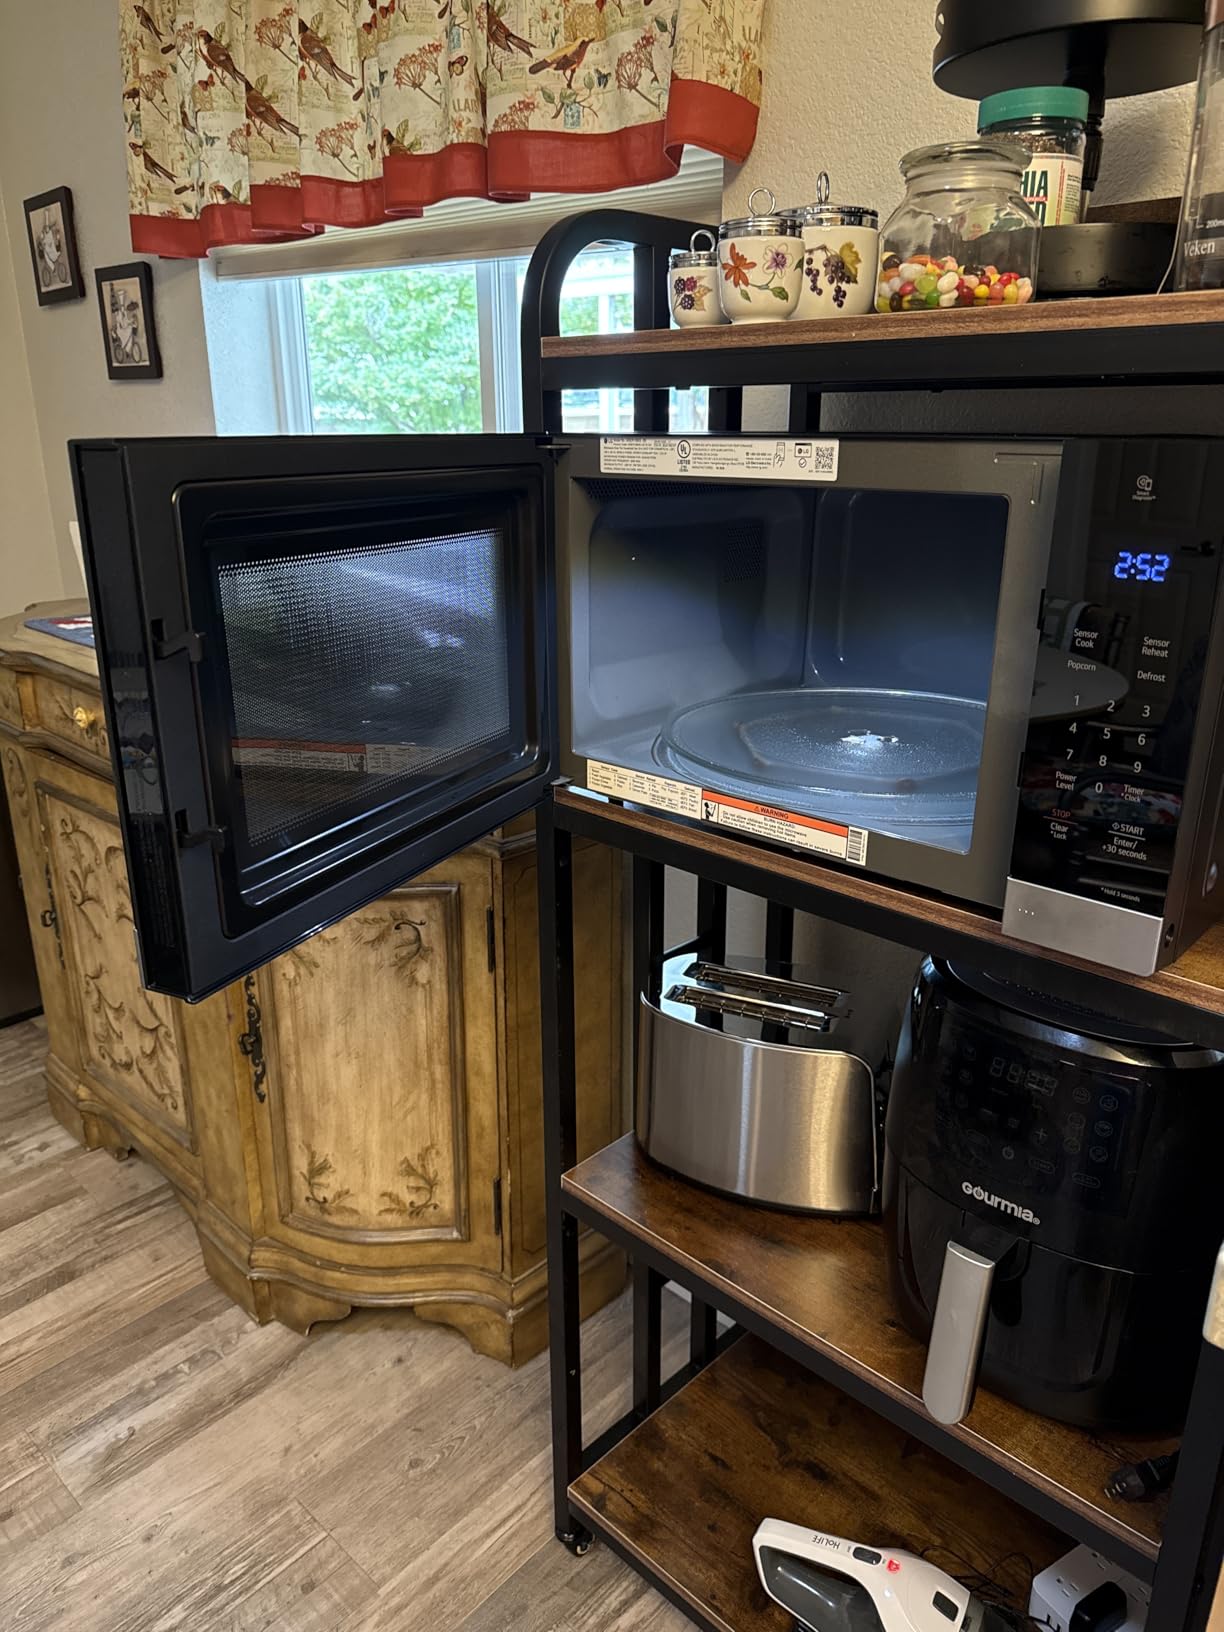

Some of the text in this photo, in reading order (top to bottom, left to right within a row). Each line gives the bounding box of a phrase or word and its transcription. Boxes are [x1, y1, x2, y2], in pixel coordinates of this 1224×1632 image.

[1184, 240, 1215, 257] Veken
[1114, 551, 1170, 582] 2:52
[1073, 628, 1099, 639] Sensor
[1075, 638, 1094, 648] Cook
[1143, 636, 1170, 648] Sensor
[1141, 646, 1168, 658] Reheat
[1067, 659, 1097, 672] Popcorn
[1137, 670, 1166, 682] Defrost
[1074, 694, 1080, 706] 1
[1106, 699, 1115, 712] 2
[1142, 705, 1151, 717] 3
[1069, 722, 1077, 734] 4
[1103, 727, 1111, 739] 5
[1137, 733, 1146, 746] 6
[1066, 748, 1074, 760] 7
[1099, 755, 1107, 767] 8
[1134, 761, 1142, 773] 9
[1055, 770, 1078, 782] Power
[1055, 780, 1075, 791] Level
[1095, 782, 1104, 793] 0
[1123, 783, 1145, 796] Timer
[760, 807, 789, 820] WARNING
[1051, 808, 1071, 818] STOP
[1050, 822, 1069, 833] Clear
[1120, 823, 1144, 836] START
[1102, 844, 1147, 861] +30 seconds
